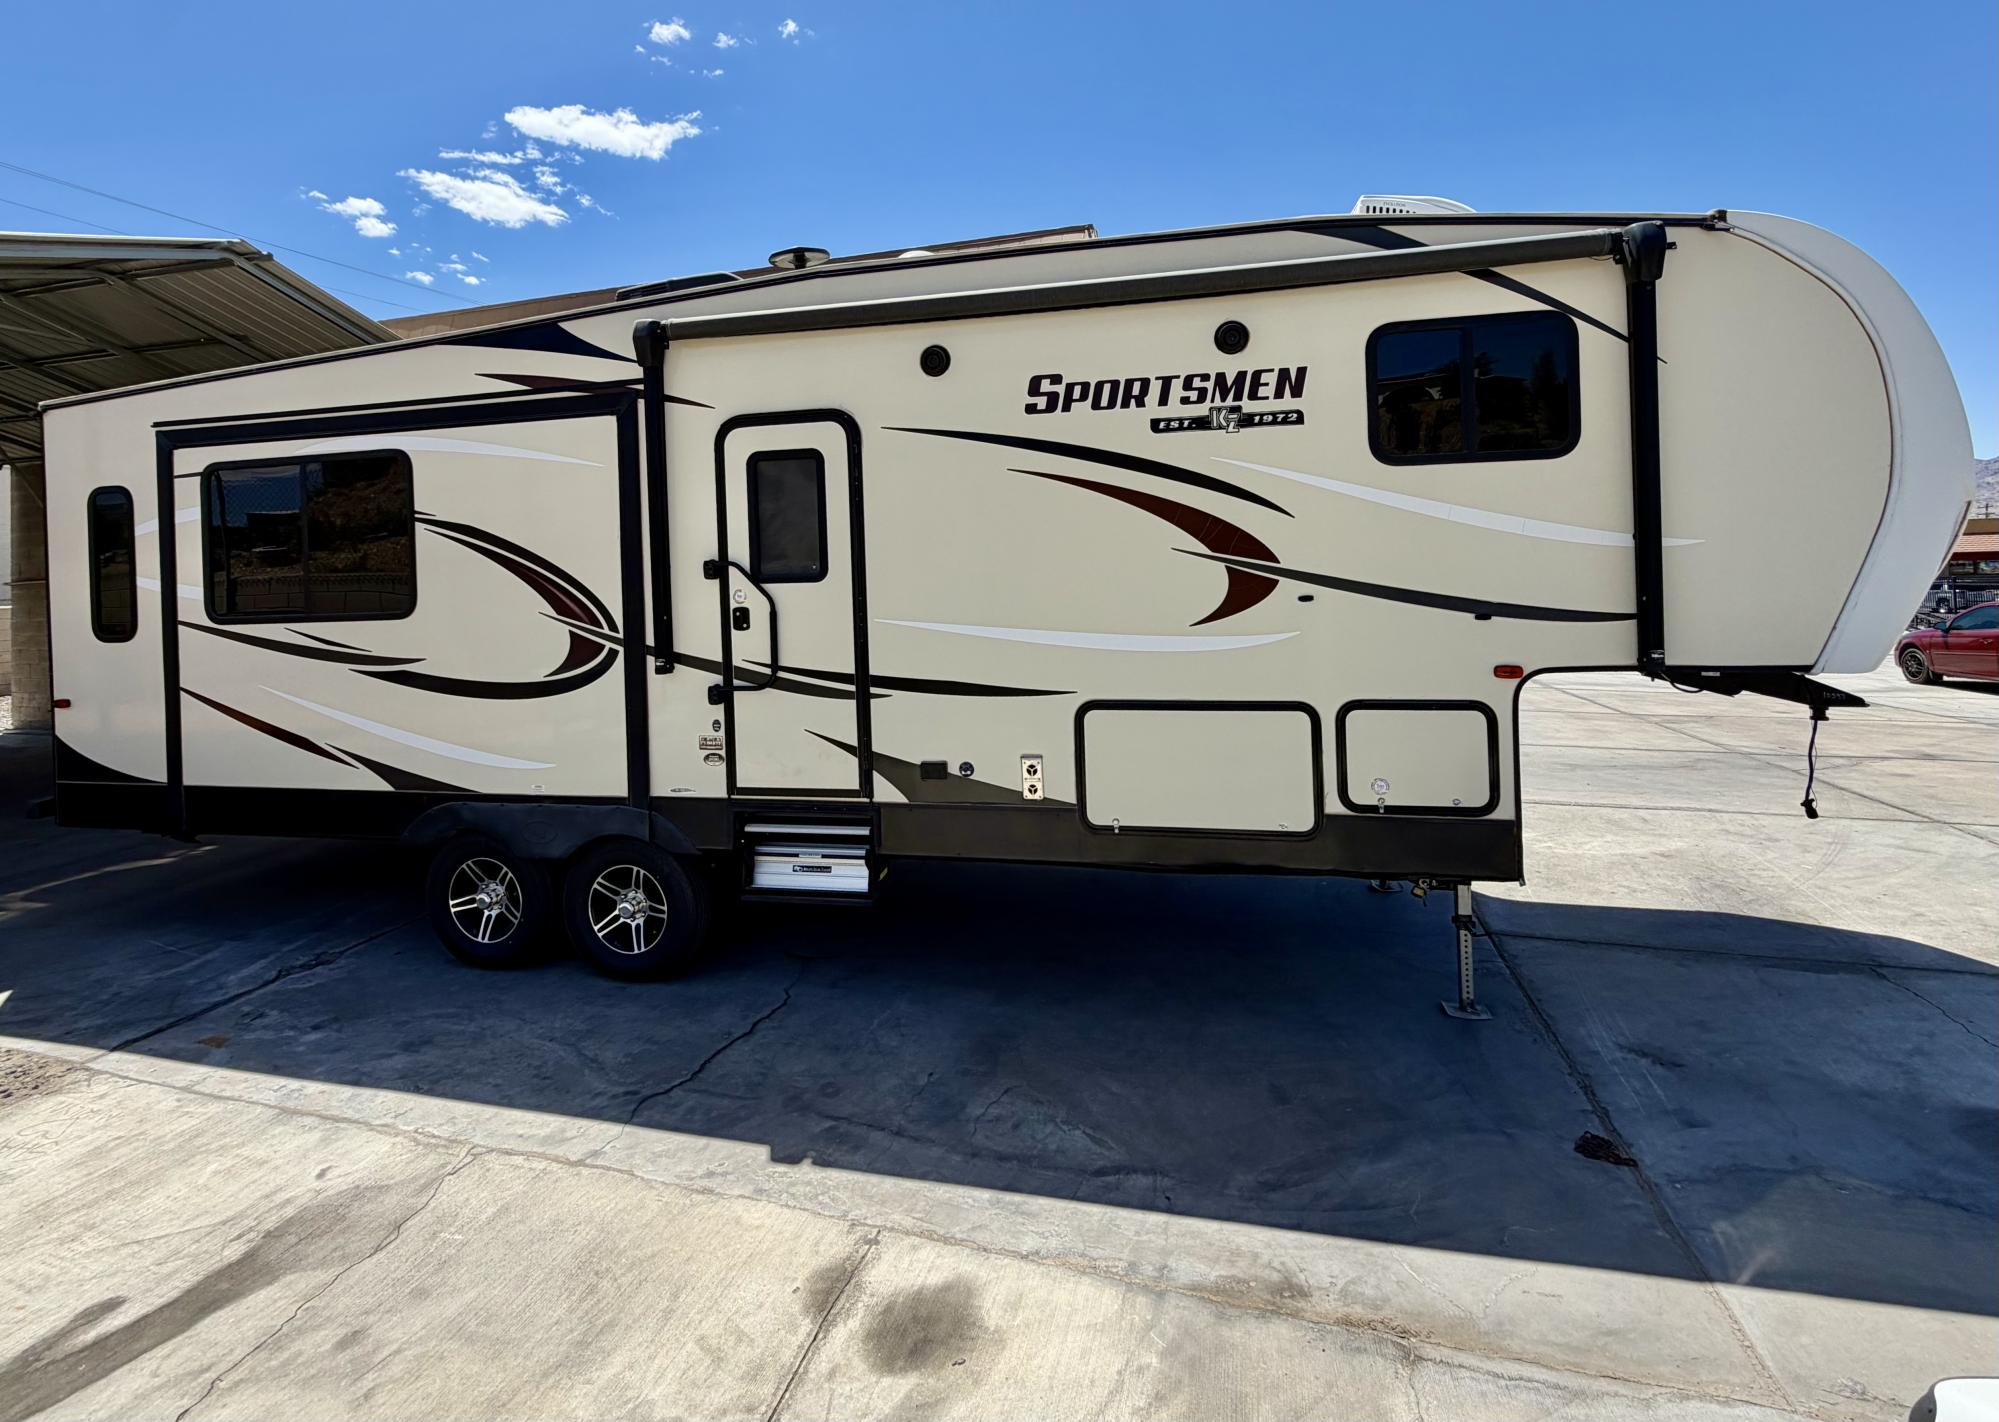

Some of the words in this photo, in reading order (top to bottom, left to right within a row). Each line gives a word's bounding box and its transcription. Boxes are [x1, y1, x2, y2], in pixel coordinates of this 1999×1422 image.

[1024, 366, 1308, 415] SPORTSMEN
[1158, 419, 1197, 430] EST.
[1252, 412, 1299, 424] 1972
